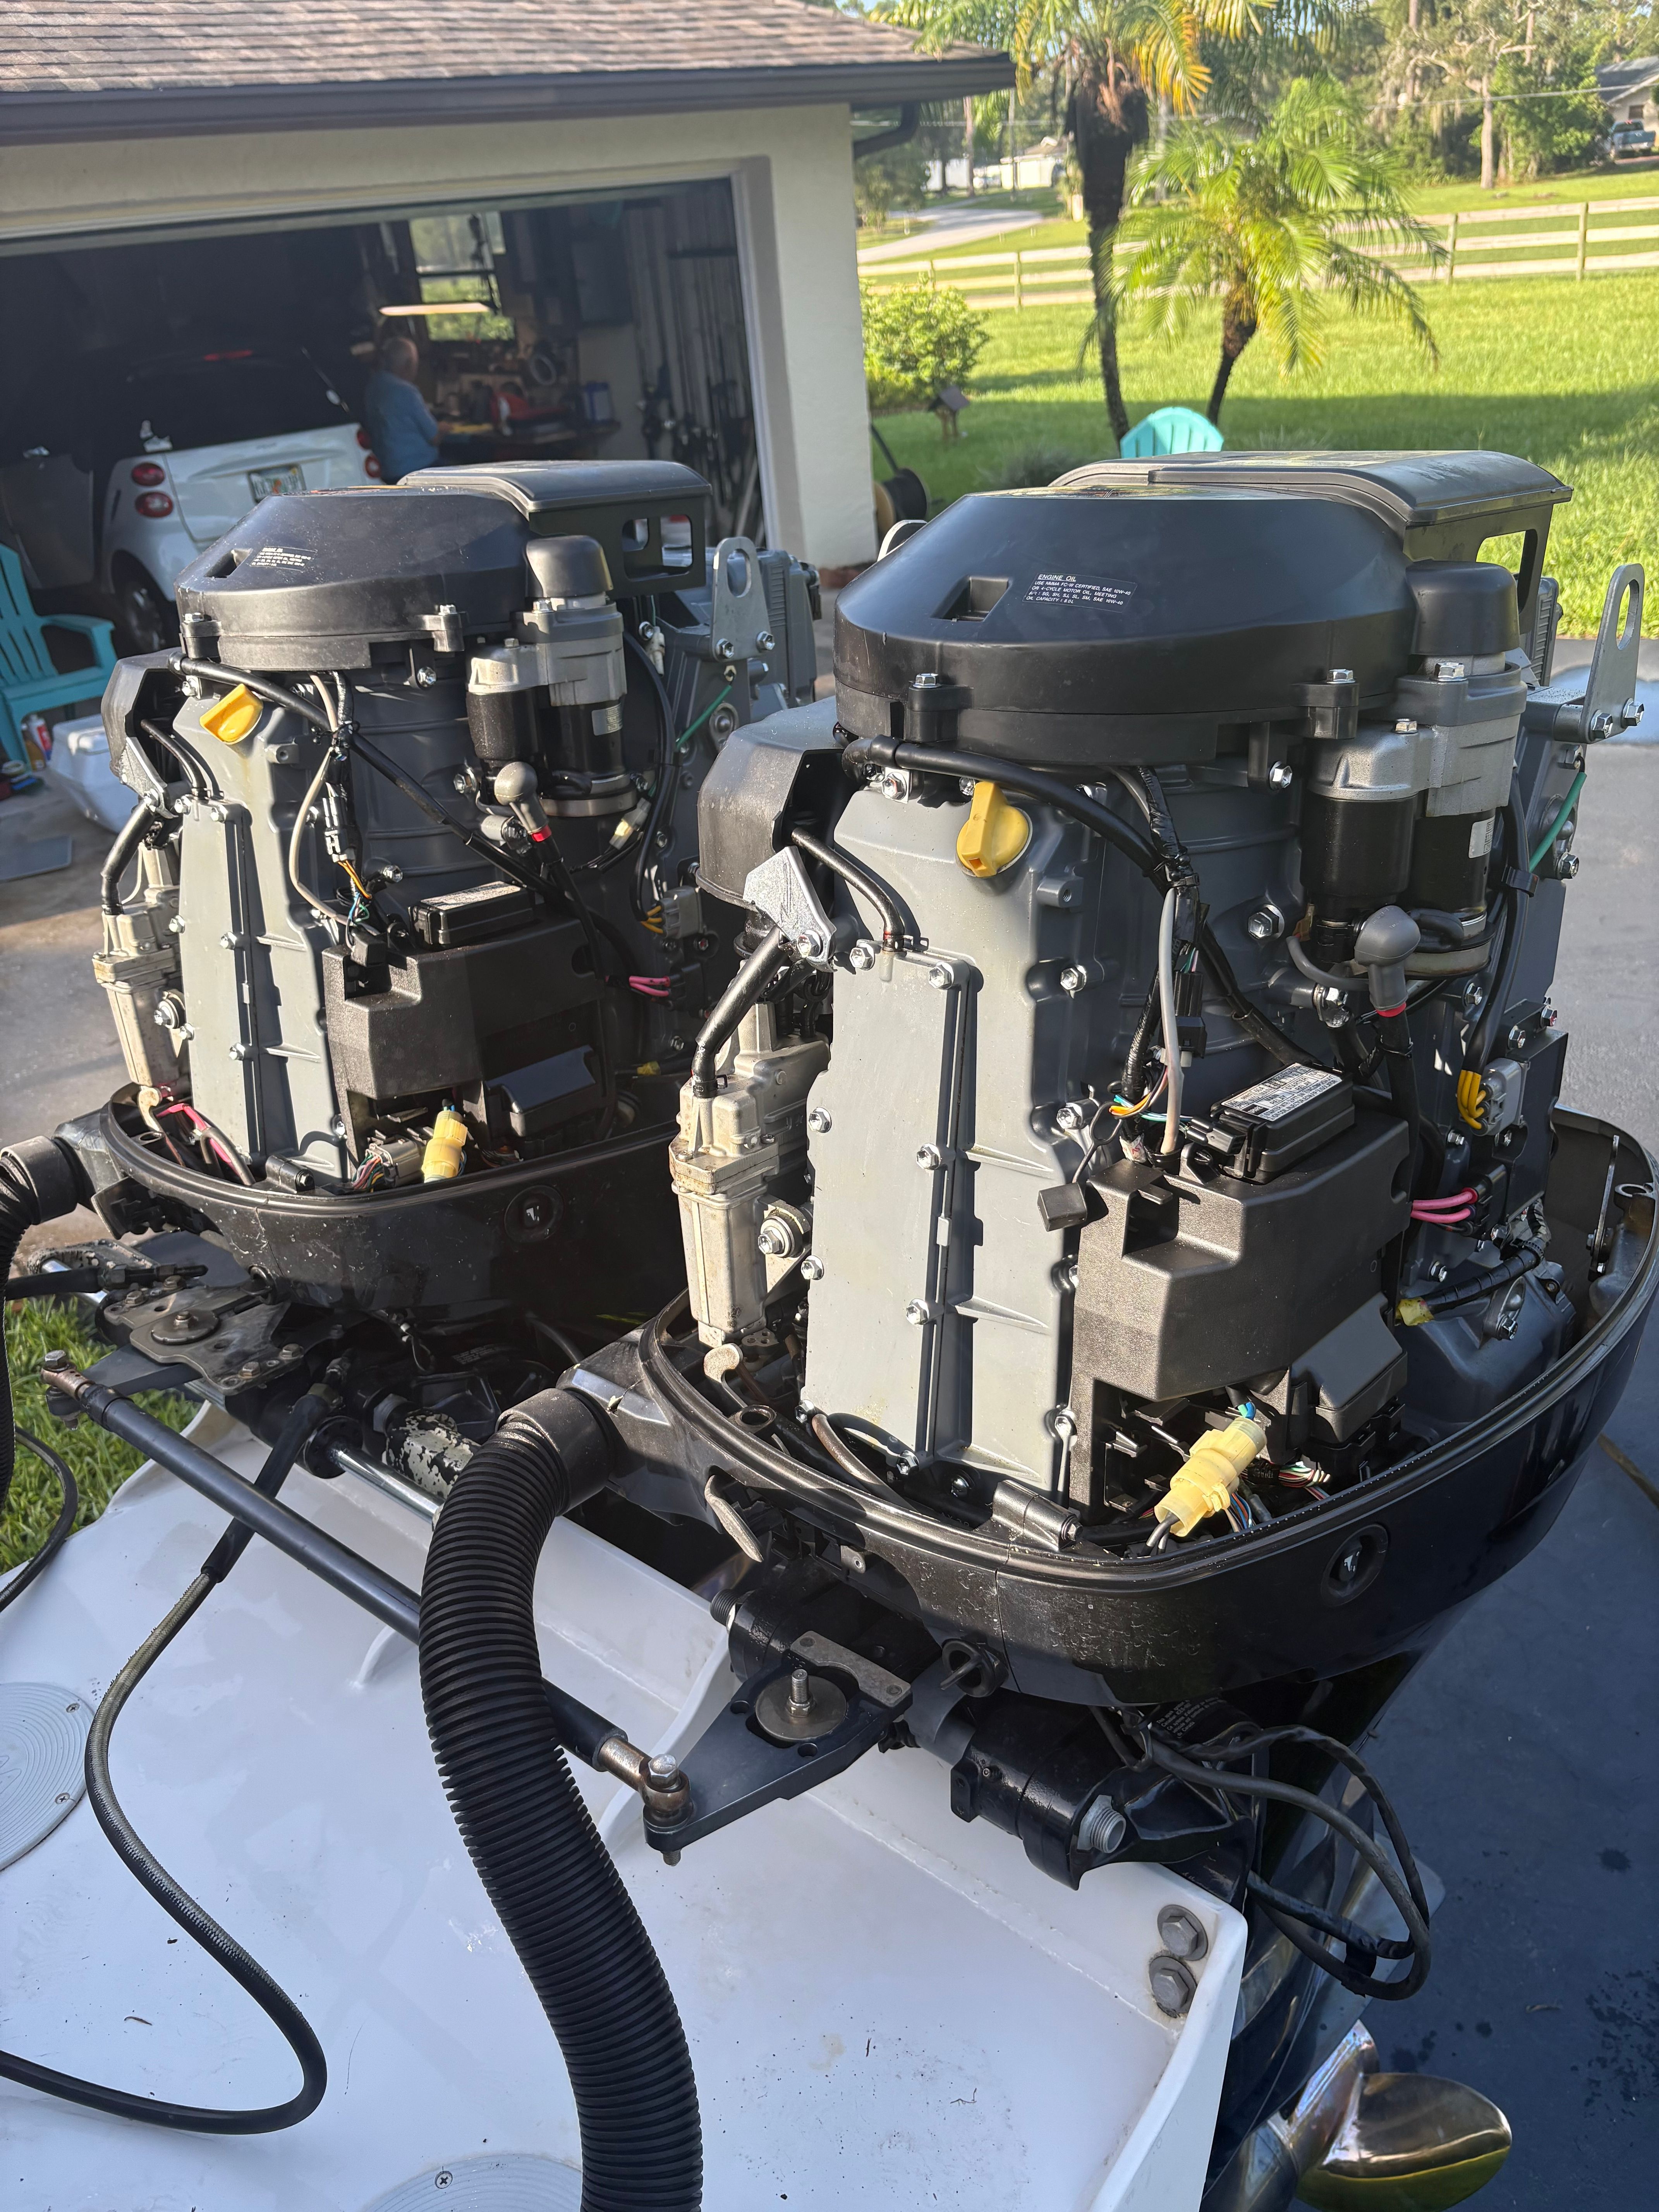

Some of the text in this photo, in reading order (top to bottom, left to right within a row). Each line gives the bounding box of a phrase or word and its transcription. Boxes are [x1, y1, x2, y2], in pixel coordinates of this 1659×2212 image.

[1285, 1077, 1309, 1091] STARTER
[1295, 1080, 1312, 1091] RELAY
[1265, 1093, 1279, 1102] MAIN
[1269, 1095, 1288, 1105] RELAY
